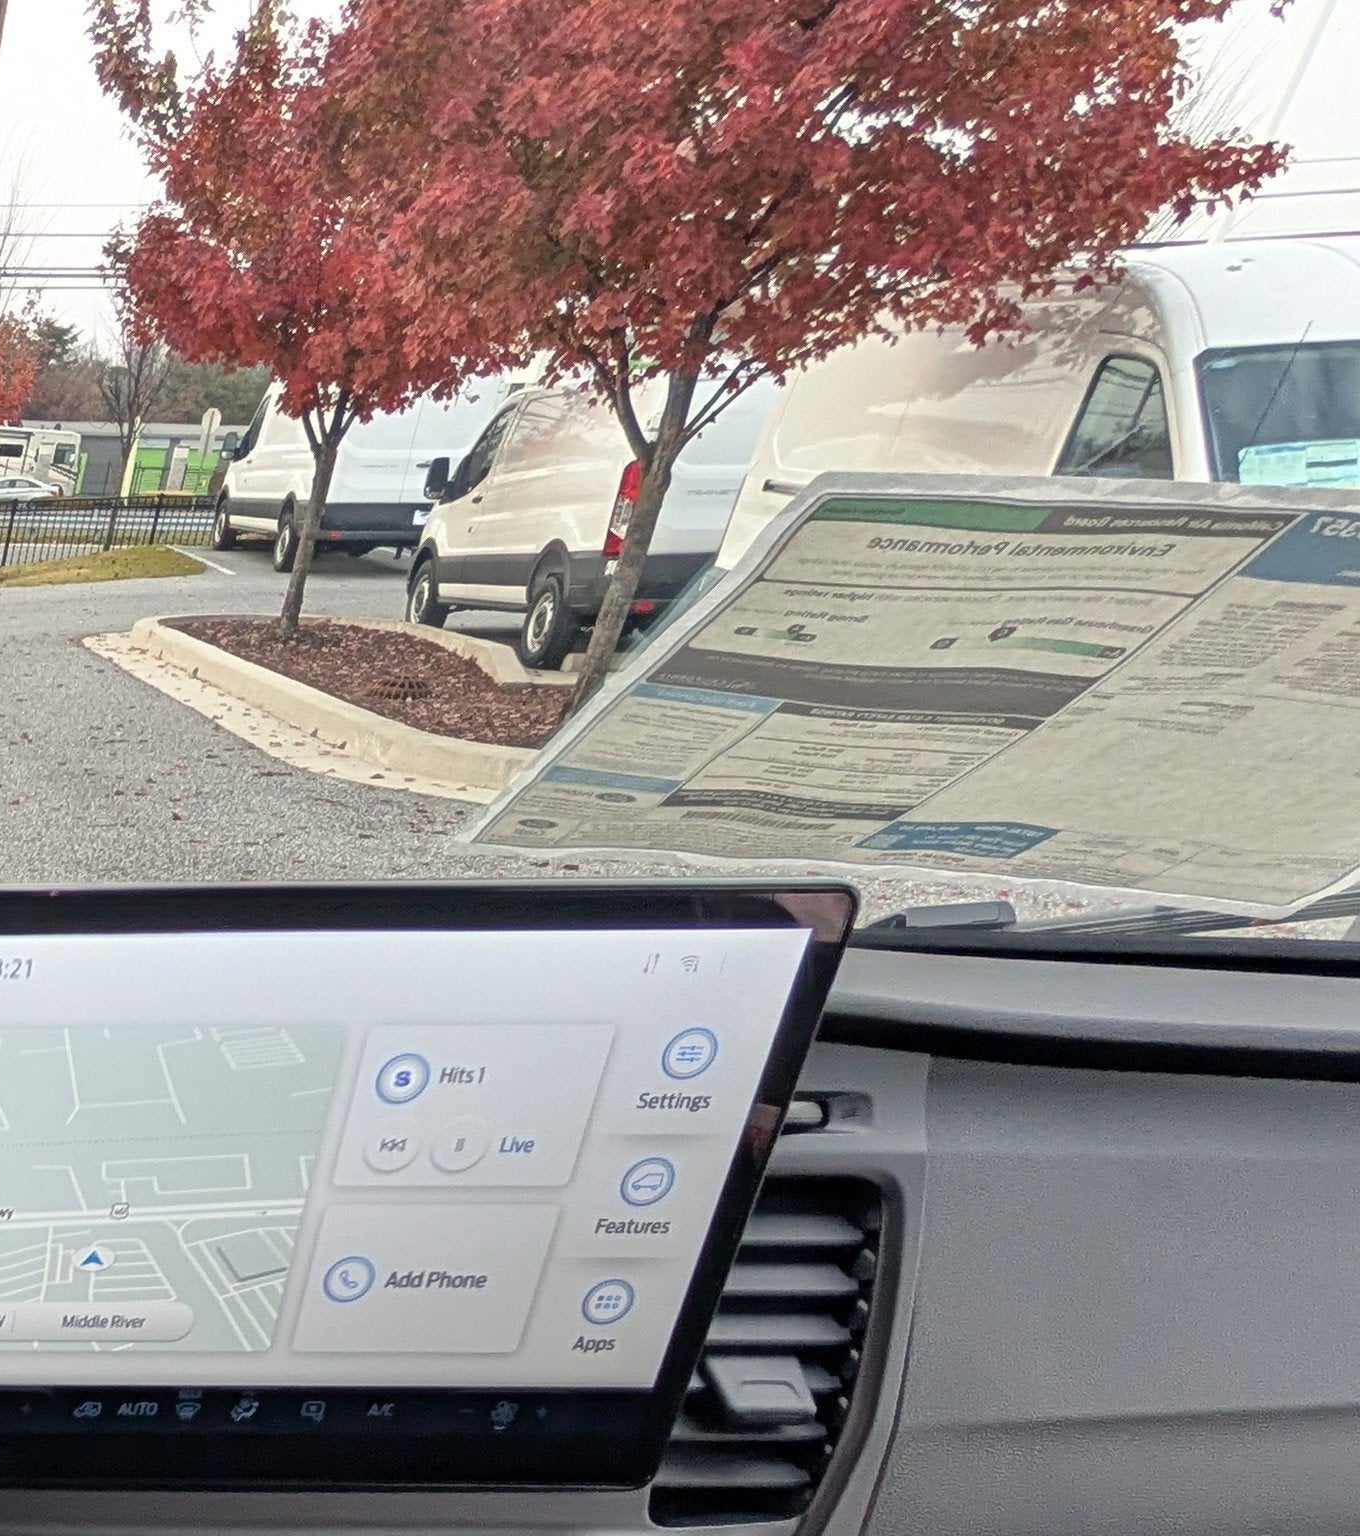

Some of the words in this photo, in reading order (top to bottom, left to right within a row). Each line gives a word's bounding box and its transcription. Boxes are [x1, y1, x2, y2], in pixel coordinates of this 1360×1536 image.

[438, 1063, 476, 1087] Hits
[636, 1090, 711, 1116] Settings
[497, 1134, 535, 1157] Live
[593, 1214, 670, 1238] Features
[383, 1268, 427, 1292] Add
[431, 1268, 487, 1292] Phone
[60, 1311, 109, 1331] Middle
[111, 1311, 146, 1330] River
[571, 1334, 616, 1357] Apps
[116, 1401, 159, 1418] AUTO
[366, 1402, 397, 1418] A/C
